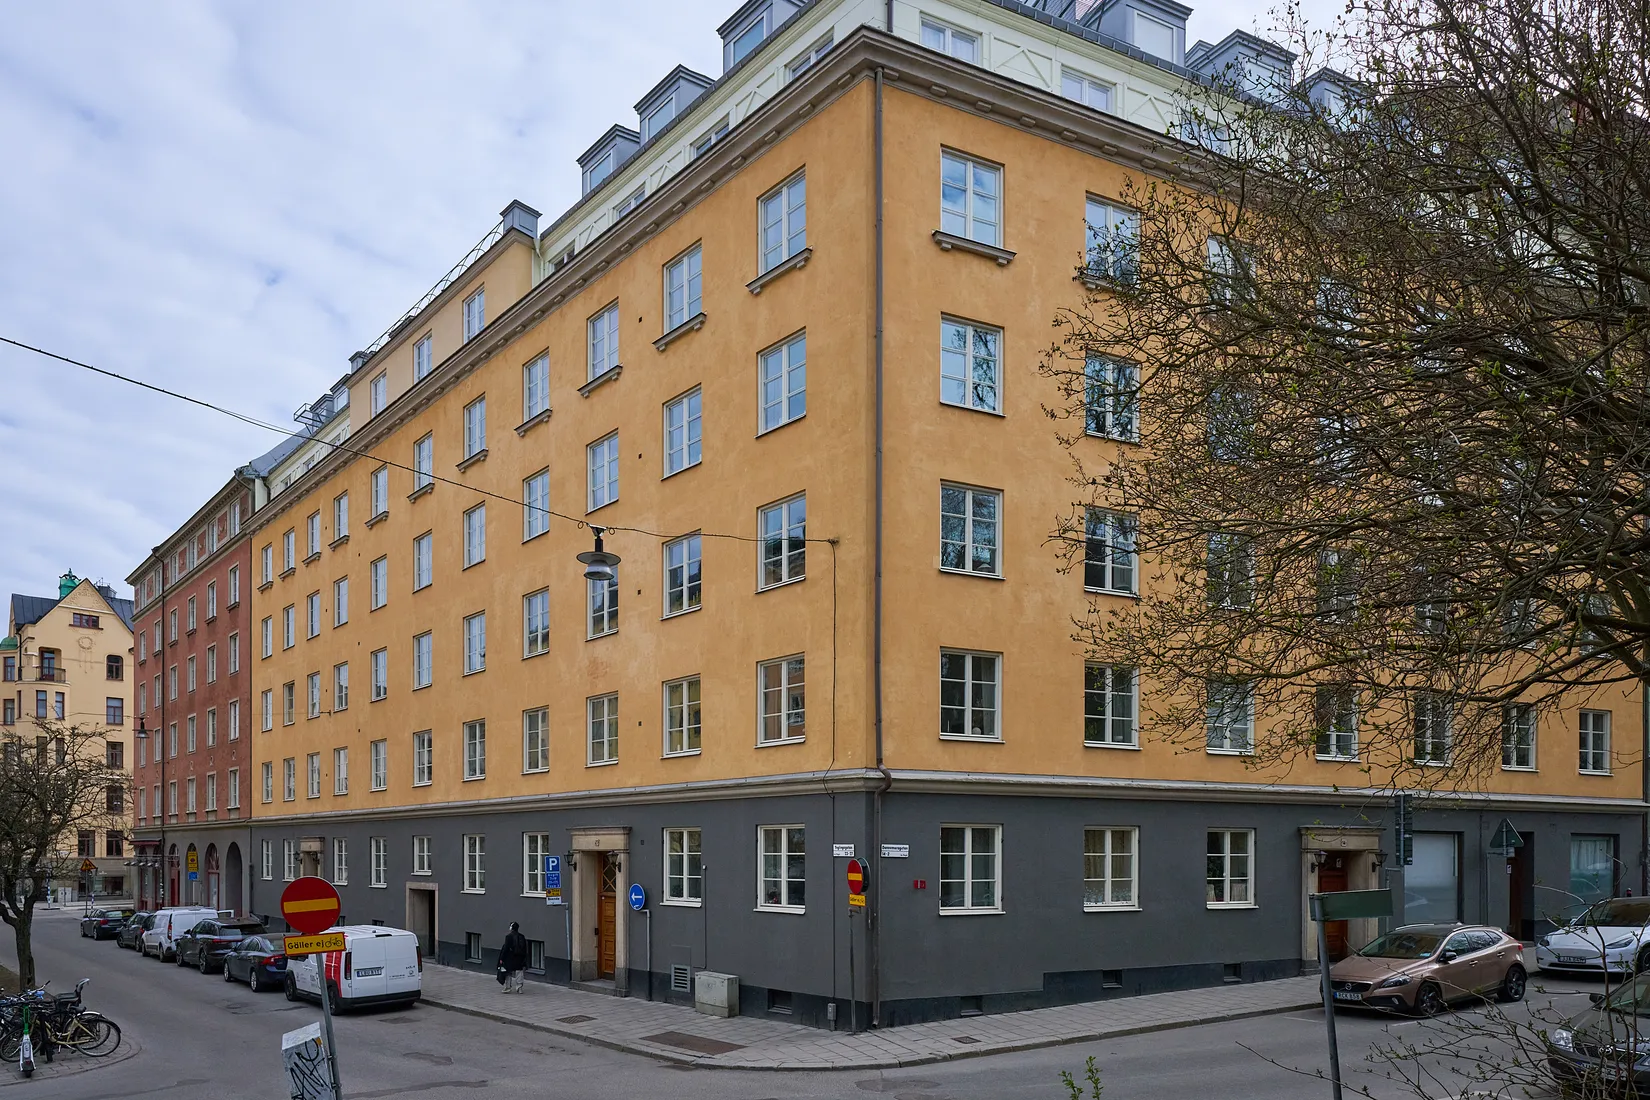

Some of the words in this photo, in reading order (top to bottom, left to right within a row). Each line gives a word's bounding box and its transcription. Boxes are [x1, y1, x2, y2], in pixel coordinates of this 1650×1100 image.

[549, 858, 558, 870] P
[288, 941, 313, 949] Gäller
[316, 940, 324, 948] ej
